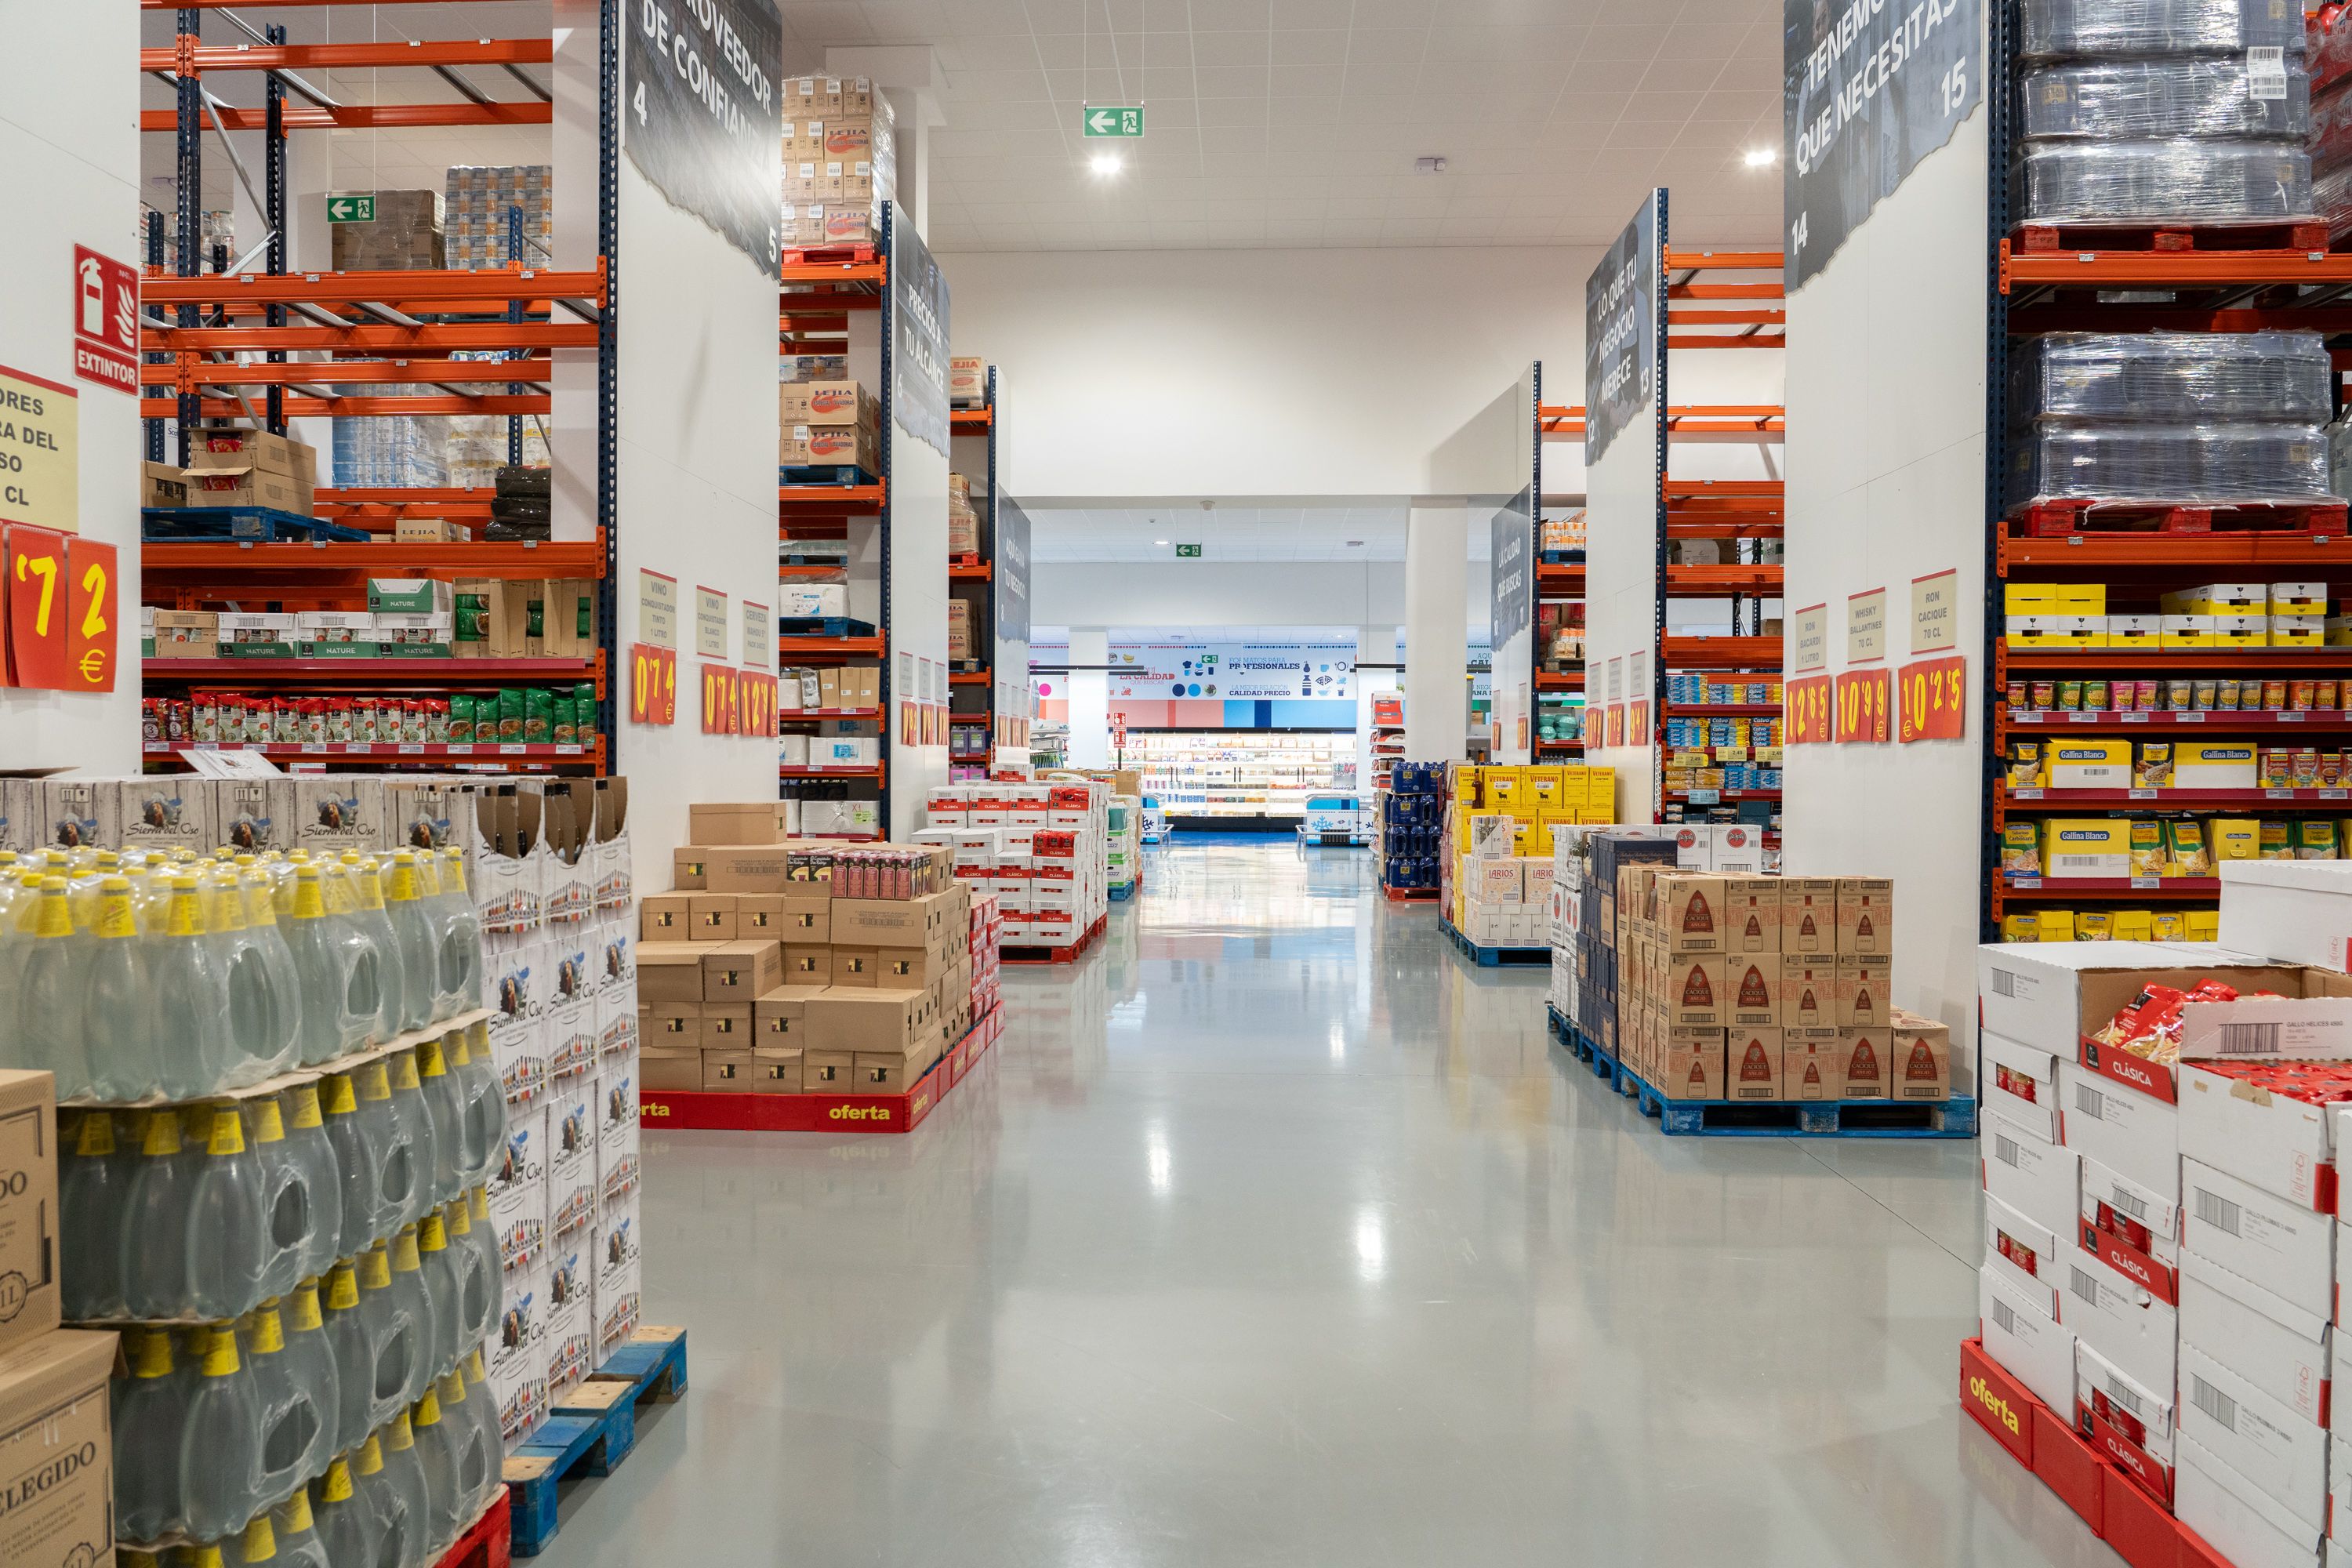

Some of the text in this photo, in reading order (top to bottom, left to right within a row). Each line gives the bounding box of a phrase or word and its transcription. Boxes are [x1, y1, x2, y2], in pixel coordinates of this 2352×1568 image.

[644, 0, 668, 57] DE
[1941, 56, 1966, 118] 15
[633, 81, 647, 127] 4
[1796, 104, 1831, 178] QUE
[1792, 210, 1808, 256] 14
[768, 226, 777, 263] 5
[1597, 253, 1637, 322] LO QUE TU
[909, 283, 942, 349] PRECIOS A
[1599, 304, 1635, 364] NEGOCIO
[78, 349, 136, 387] EXTINTOR
[905, 325, 944, 394] TU ALCANCE
[897, 373, 902, 398] 6
[1602, 354, 1632, 405] MERECE
[1639, 366, 1650, 397] 13
[24, 426, 59, 452] DEL
[1587, 419, 1595, 444] 12
[5, 486, 29, 506] CL
[1498, 537, 1521, 568] LA CALIDAD
[1005, 568, 1011, 588] TU
[1497, 569, 1522, 602] QUE BUSCAS
[651, 580, 667, 597] VINO
[1926, 590, 1940, 603] RON
[641, 597, 675, 614] CONQUISTADOR
[706, 597, 719, 610] VINO
[1855, 605, 1877, 619] WHISKY
[652, 614, 666, 625] TINTO
[746, 609, 767, 623] CERVEZA
[1918, 607, 1947, 622] CACIQUE
[655, 630, 667, 639] LITRO
[1805, 621, 1815, 631] RON
[1849, 620, 1882, 634] BALLANTINES
[1923, 627, 1942, 639] 70 CL
[1858, 638, 1873, 648] 70 CL
[1805, 652, 1819, 663] LITRO
[2060, 750, 2104, 759] Gallina Blanca
[2203, 750, 2249, 759] Gallina Blanca
[126, 822, 199, 836] Sierra del Oso
[301, 823, 376, 837] Sierra del Oso
[1489, 869, 1514, 879] LARIOS
[2112, 1061, 2153, 1087] CLÁSICA
[829, 1105, 891, 1120] oferta
[526, 1162, 543, 1180] Oso
[2111, 1250, 2151, 1284] CLÁSICA
[531, 1323, 546, 1341] Oso
[1969, 1375, 2019, 1436] oferta
[2107, 1437, 2146, 1478] CLÁSICA
